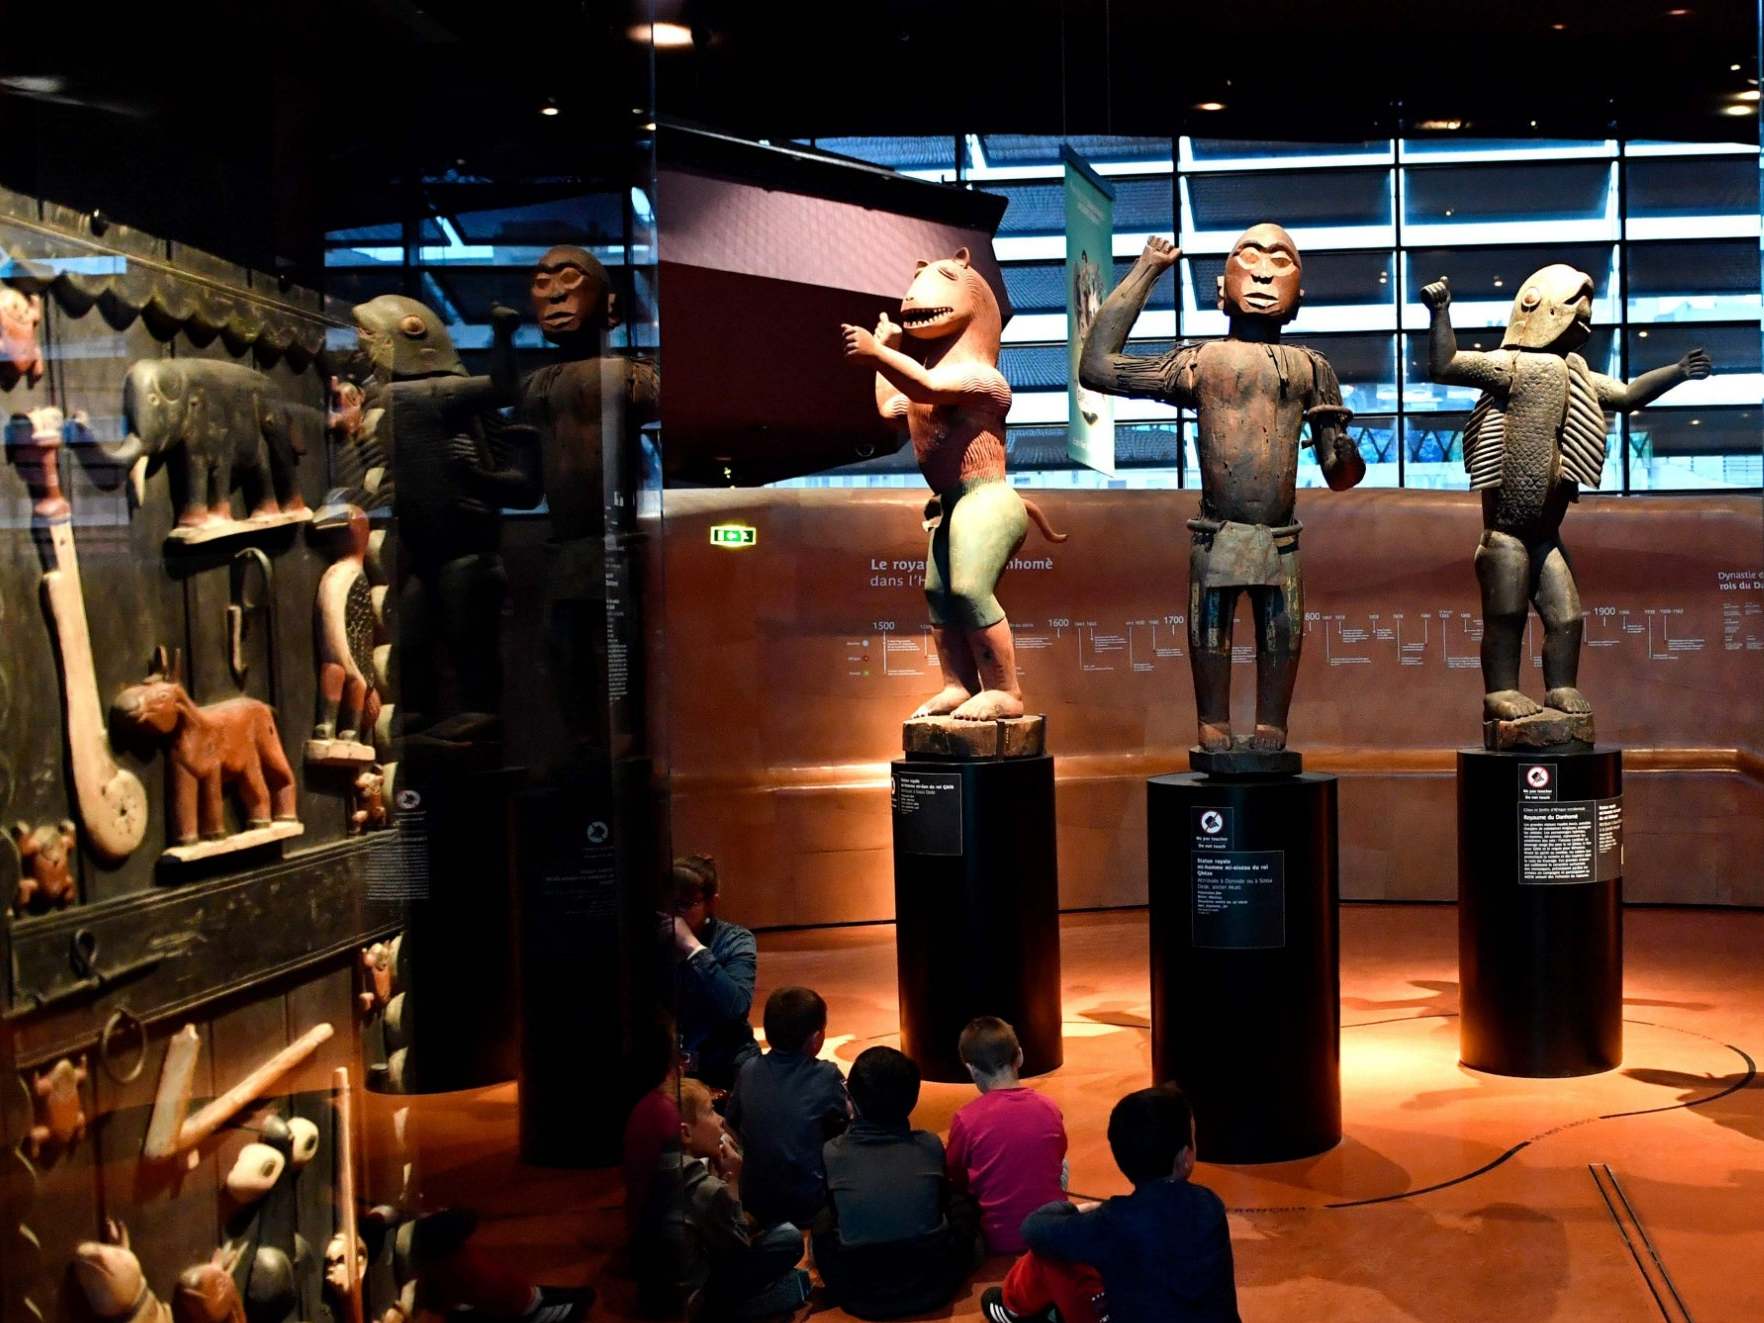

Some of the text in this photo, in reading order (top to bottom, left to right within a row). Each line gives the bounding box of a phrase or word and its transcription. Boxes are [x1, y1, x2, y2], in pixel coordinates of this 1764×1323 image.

[871, 559, 887, 570] Le
[893, 560, 925, 573] roya
[1718, 570, 1756, 581] Dynastie
[870, 576, 904, 587] dans
[1720, 581, 1738, 590] rois
[1738, 581, 1752, 590] du
[1304, 612, 1321, 621] 800
[1594, 607, 1616, 616] 1900
[1047, 618, 1069, 628] 1600
[1164, 615, 1184, 625] 1700
[873, 621, 895, 631] 1500
